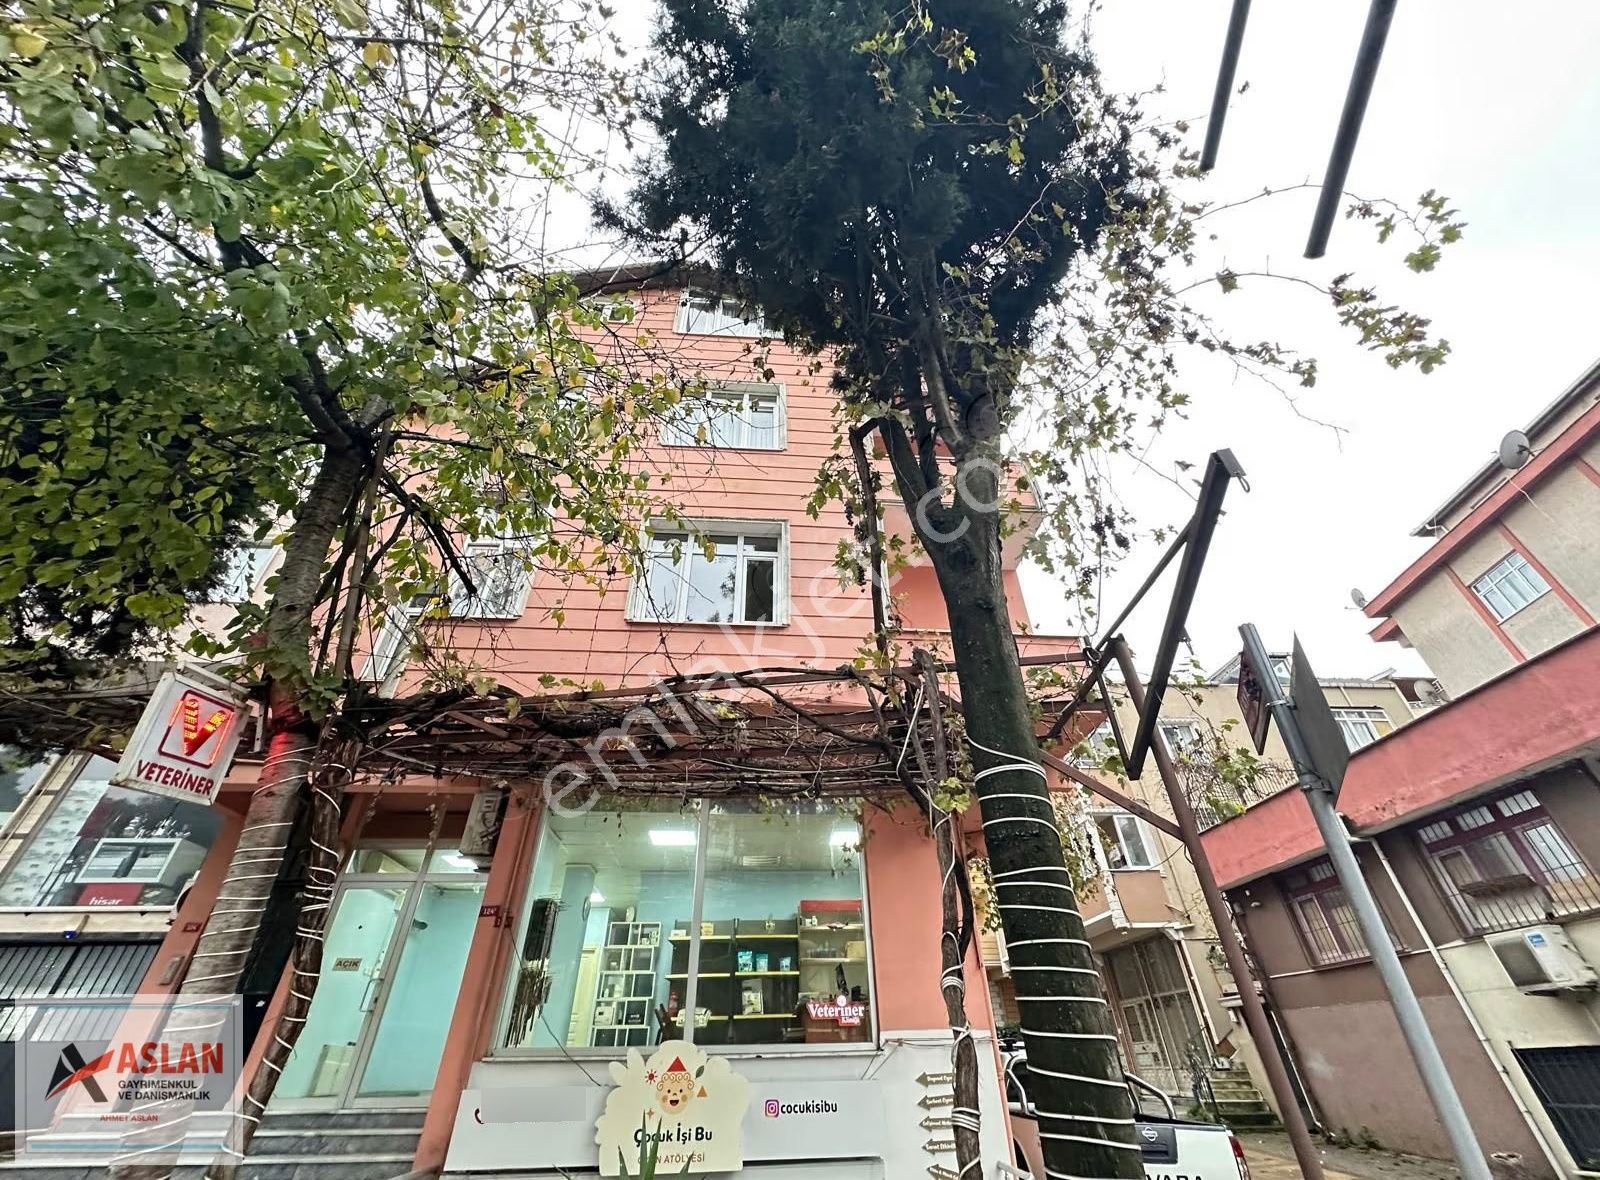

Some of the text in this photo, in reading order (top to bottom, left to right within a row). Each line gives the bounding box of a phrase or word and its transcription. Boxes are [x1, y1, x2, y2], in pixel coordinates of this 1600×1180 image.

[137, 759, 214, 796] VETERİNER
[89, 896, 123, 905] hisar
[335, 960, 360, 968] AÇIK
[807, 1003, 865, 1018] Veteriner
[780, 1100, 838, 1114] cocukisibu
[676, 1122, 692, 1145] İşi
[695, 1126, 713, 1141] Bu
